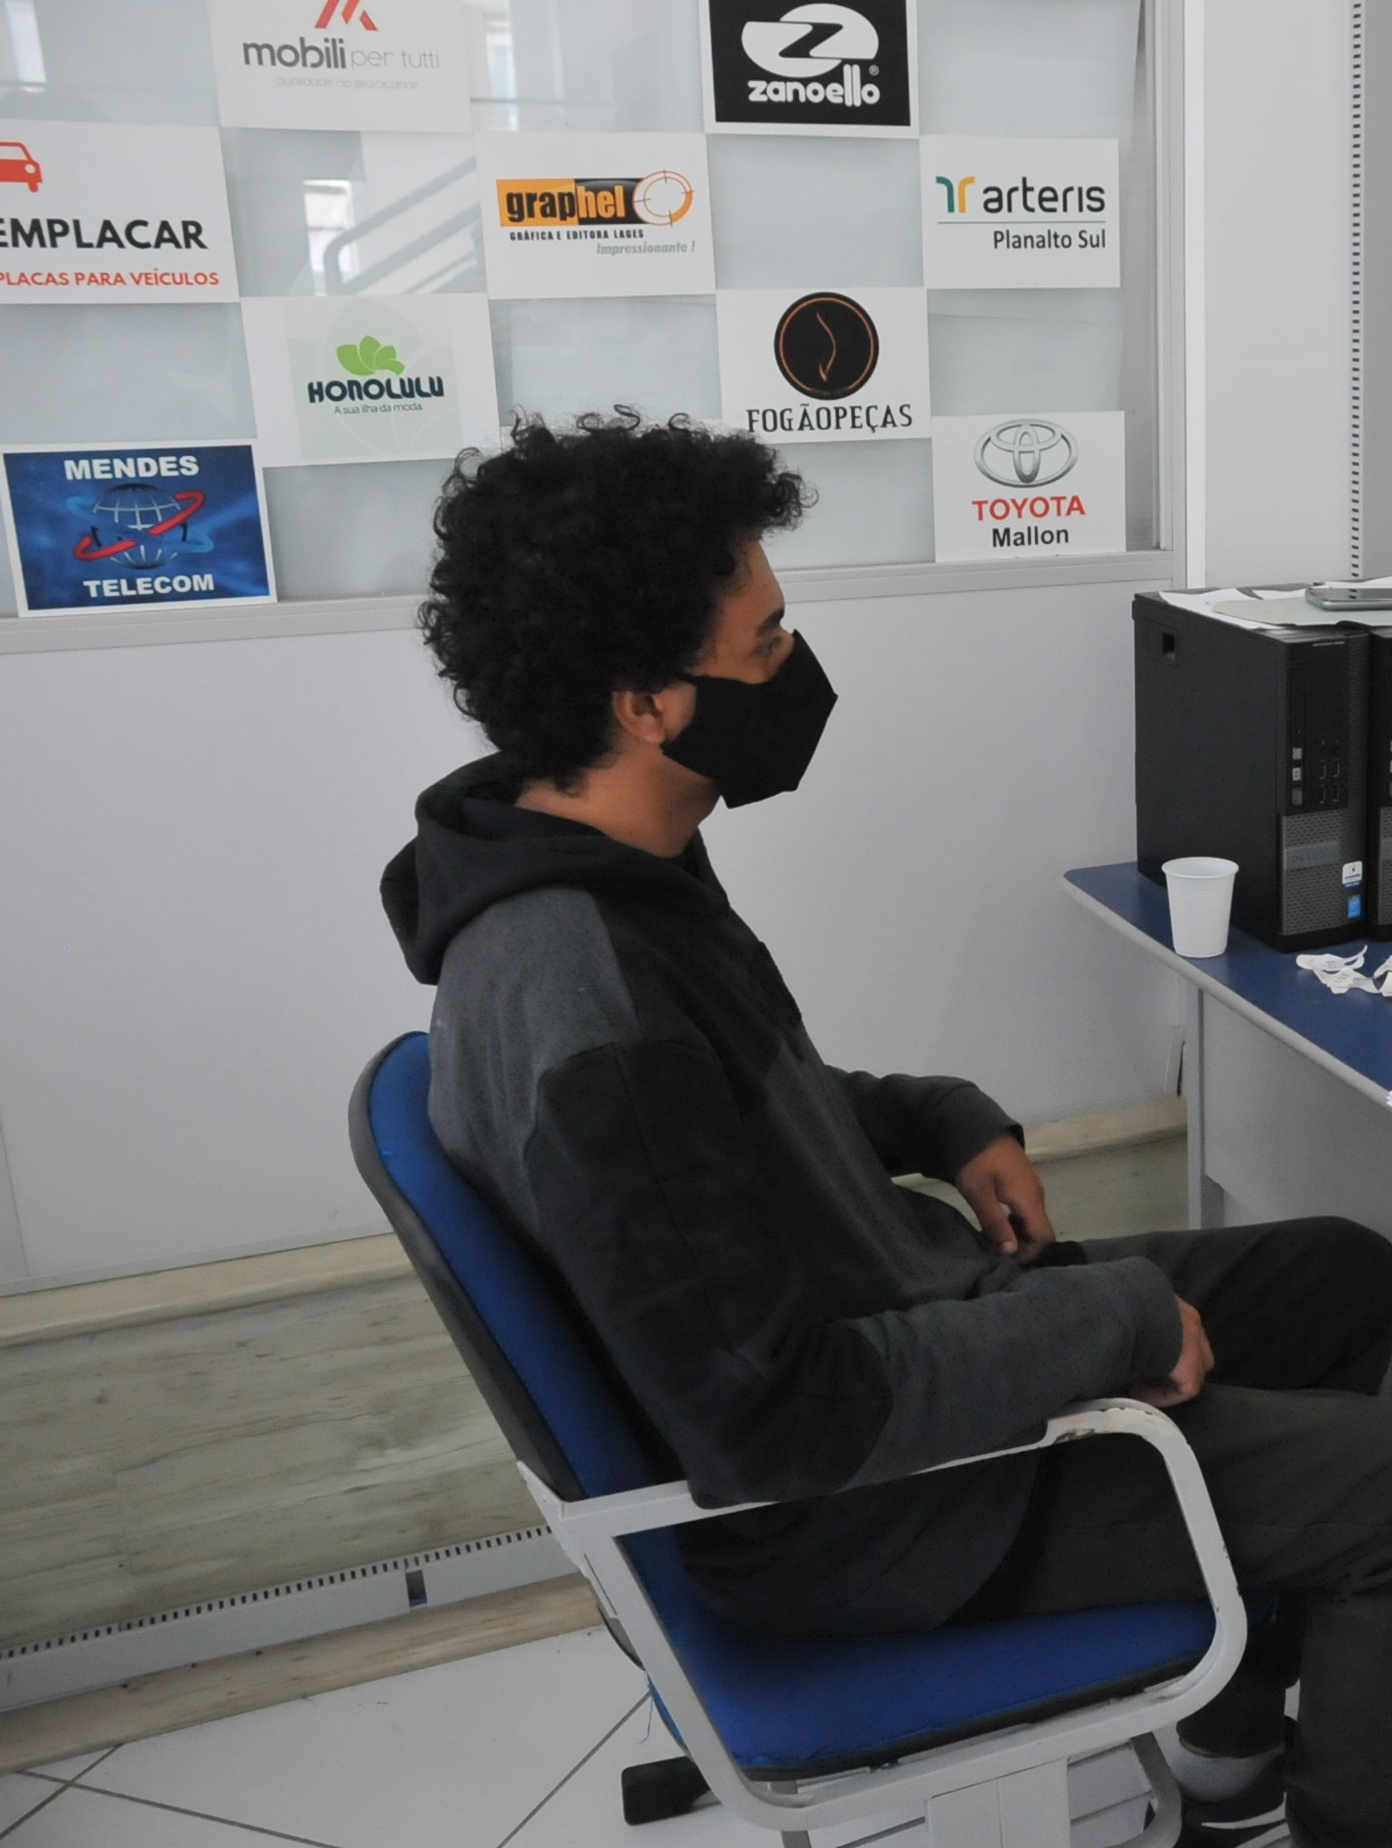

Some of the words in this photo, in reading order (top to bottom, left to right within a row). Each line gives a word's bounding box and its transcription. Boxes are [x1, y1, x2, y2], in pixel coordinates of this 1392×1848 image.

[242, 36, 347, 69] mobili
[350, 49, 393, 70] per
[402, 49, 440, 68] tutti
[747, 63, 881, 107] zanoello
[505, 184, 627, 223] graphel
[982, 176, 1106, 213] arteris
[509, 229, 554, 241] GRÁFICA
[556, 230, 562, 240] E
[566, 229, 610, 240] EDITORA
[613, 229, 644, 239] LAGES
[596, 241, 688, 256] Impressionante
[993, 229, 1073, 249] Planalto
[1077, 228, 1106, 248] Sul
[74, 271, 127, 286] PARA
[130, 267, 220, 286] VEÍCULOS
[307, 375, 445, 403] HONOLULU
[334, 405, 342, 415] A
[343, 406, 360, 414] sua
[362, 404, 378, 413] ilha
[380, 403, 392, 413] da
[746, 402, 913, 434] FOGÃOPEÇAS
[64, 454, 200, 481] MENDES
[972, 495, 1086, 522] TOYOTA
[991, 526, 1070, 549] Mallon
[83, 573, 215, 599] TELECOM
